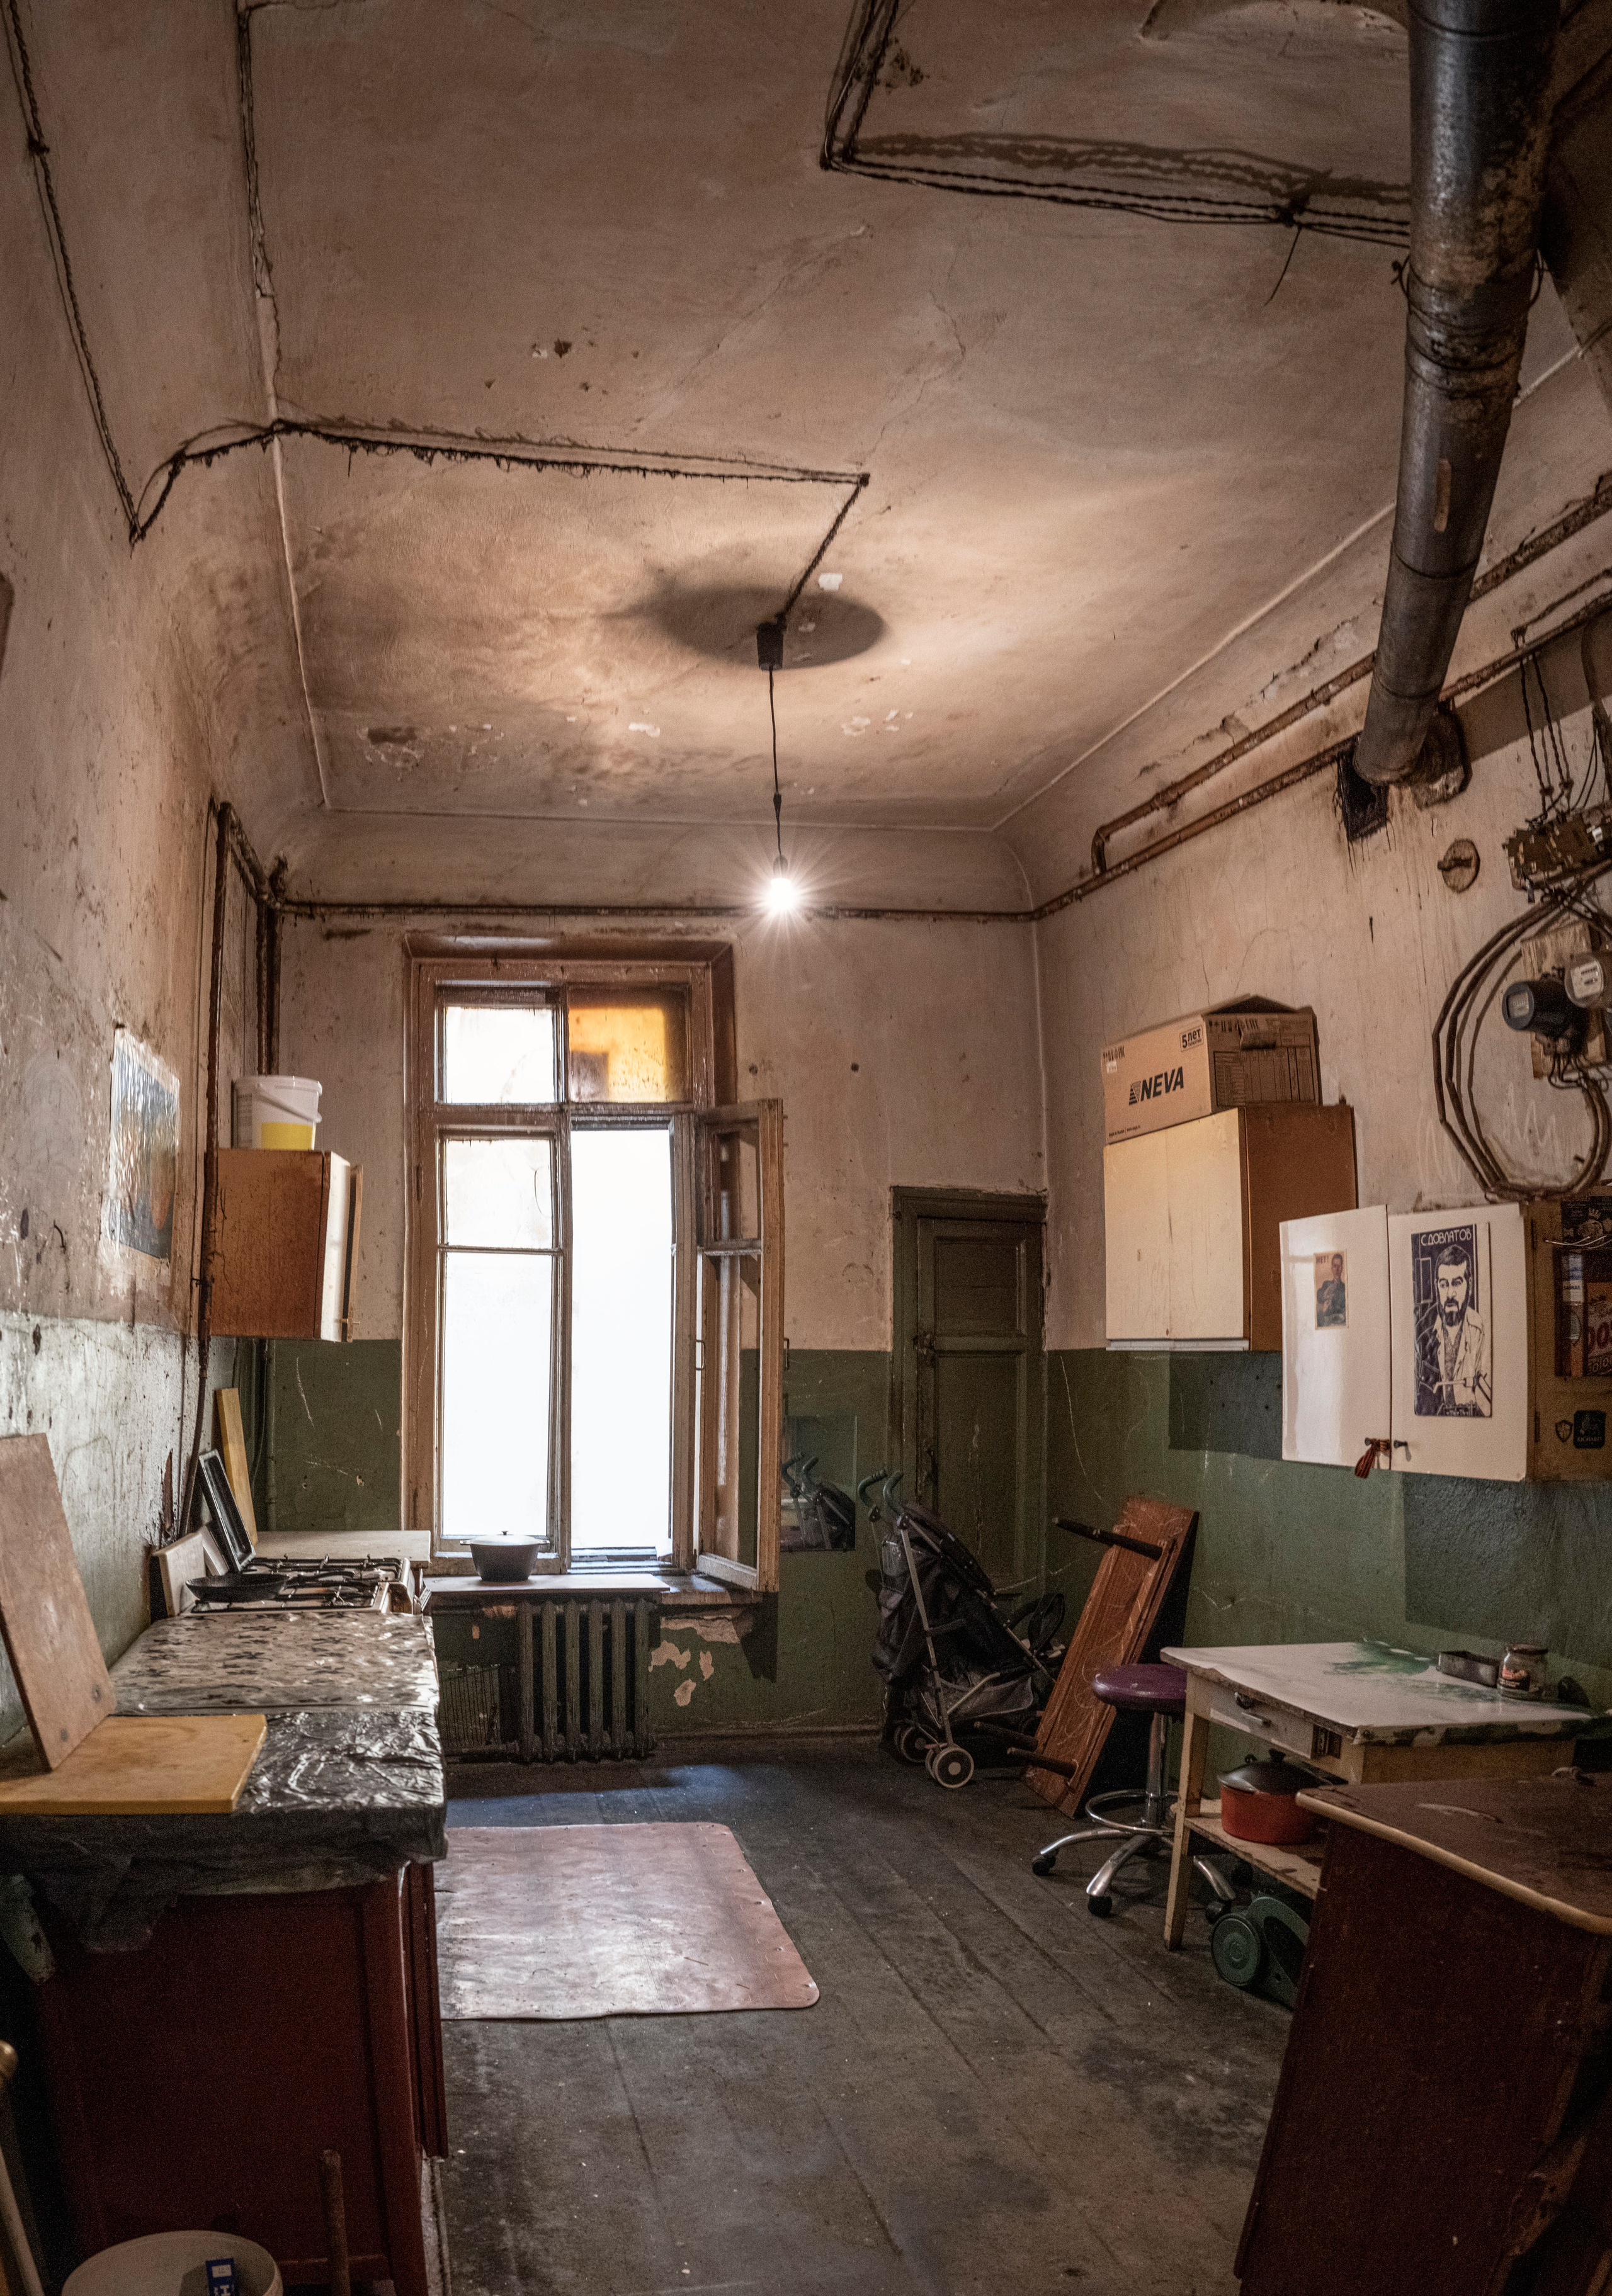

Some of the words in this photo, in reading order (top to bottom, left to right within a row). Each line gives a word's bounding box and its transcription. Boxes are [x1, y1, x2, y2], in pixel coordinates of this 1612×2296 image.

[1182, 1034, 1188, 1048] 5
[1188, 1029, 1200, 1041] лет
[1140, 1066, 1184, 1102] NEVA
